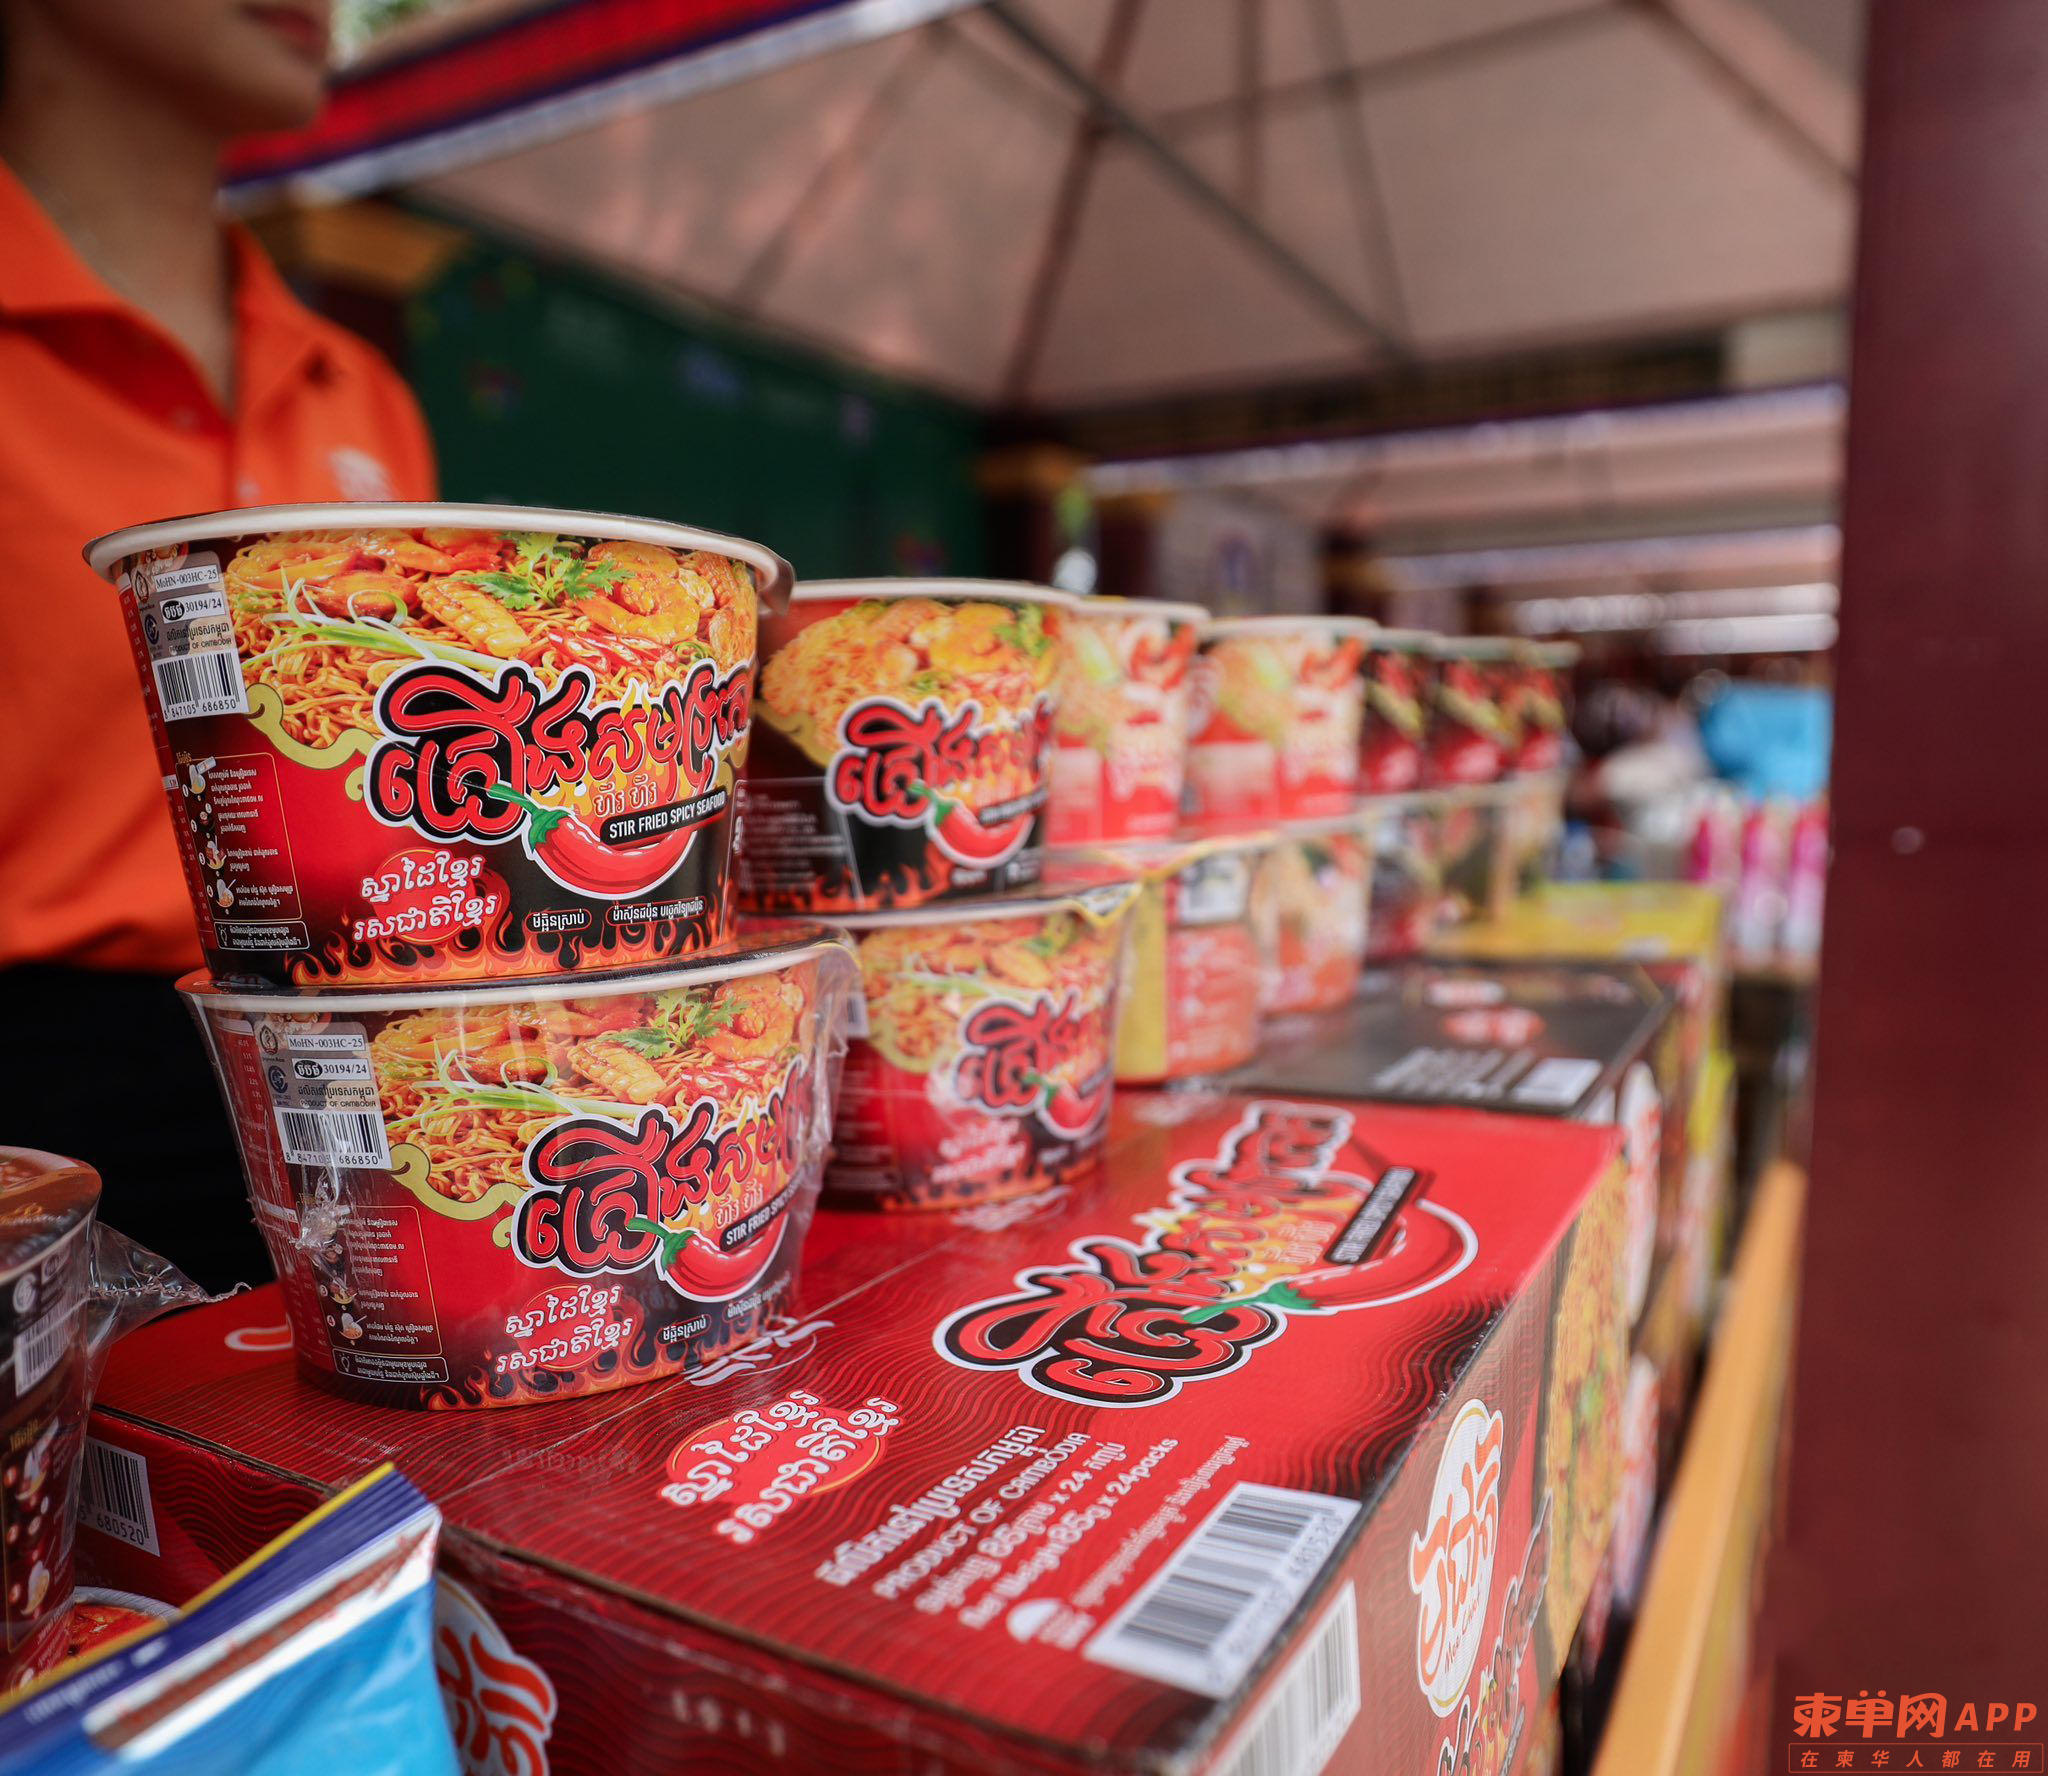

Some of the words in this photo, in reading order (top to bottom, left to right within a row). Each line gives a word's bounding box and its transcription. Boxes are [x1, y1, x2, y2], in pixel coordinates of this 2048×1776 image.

[185, 598, 222, 611] 30194/24
[202, 699, 236, 712] 686850
[609, 822, 636, 839] STIR
[638, 812, 668, 833] FRIED
[670, 803, 695, 825] SPICY
[696, 791, 726, 816] SEAFOOD
[362, 852, 482, 902] ស្នាដៃខ្មែរ
[354, 890, 497, 940] រសជាតិខ្មែរ
[289, 1038, 363, 1049] MoHN-003HC-25
[324, 1064, 367, 1075] 30194/24
[338, 1154, 378, 1165] 686850
[726, 1226, 747, 1245] STIR
[748, 1207, 770, 1235] FRIED
[505, 1286, 621, 1338] ស្នាដៃខ្មែរ
[497, 1317, 633, 1373] រសជាតិខ្មែរ
[661, 1391, 820, 1505] ស្នាដៃខ្មែរ
[718, 1398, 900, 1543] រសជាតិខ្មែរ
[1059, 1468, 1093, 1495] 24
[97, 1515, 144, 1545] 680520
[872, 1523, 978, 1599] PRODUCT
[969, 1497, 1004, 1525] OF
[997, 1432, 1091, 1500] CAMBODIA
